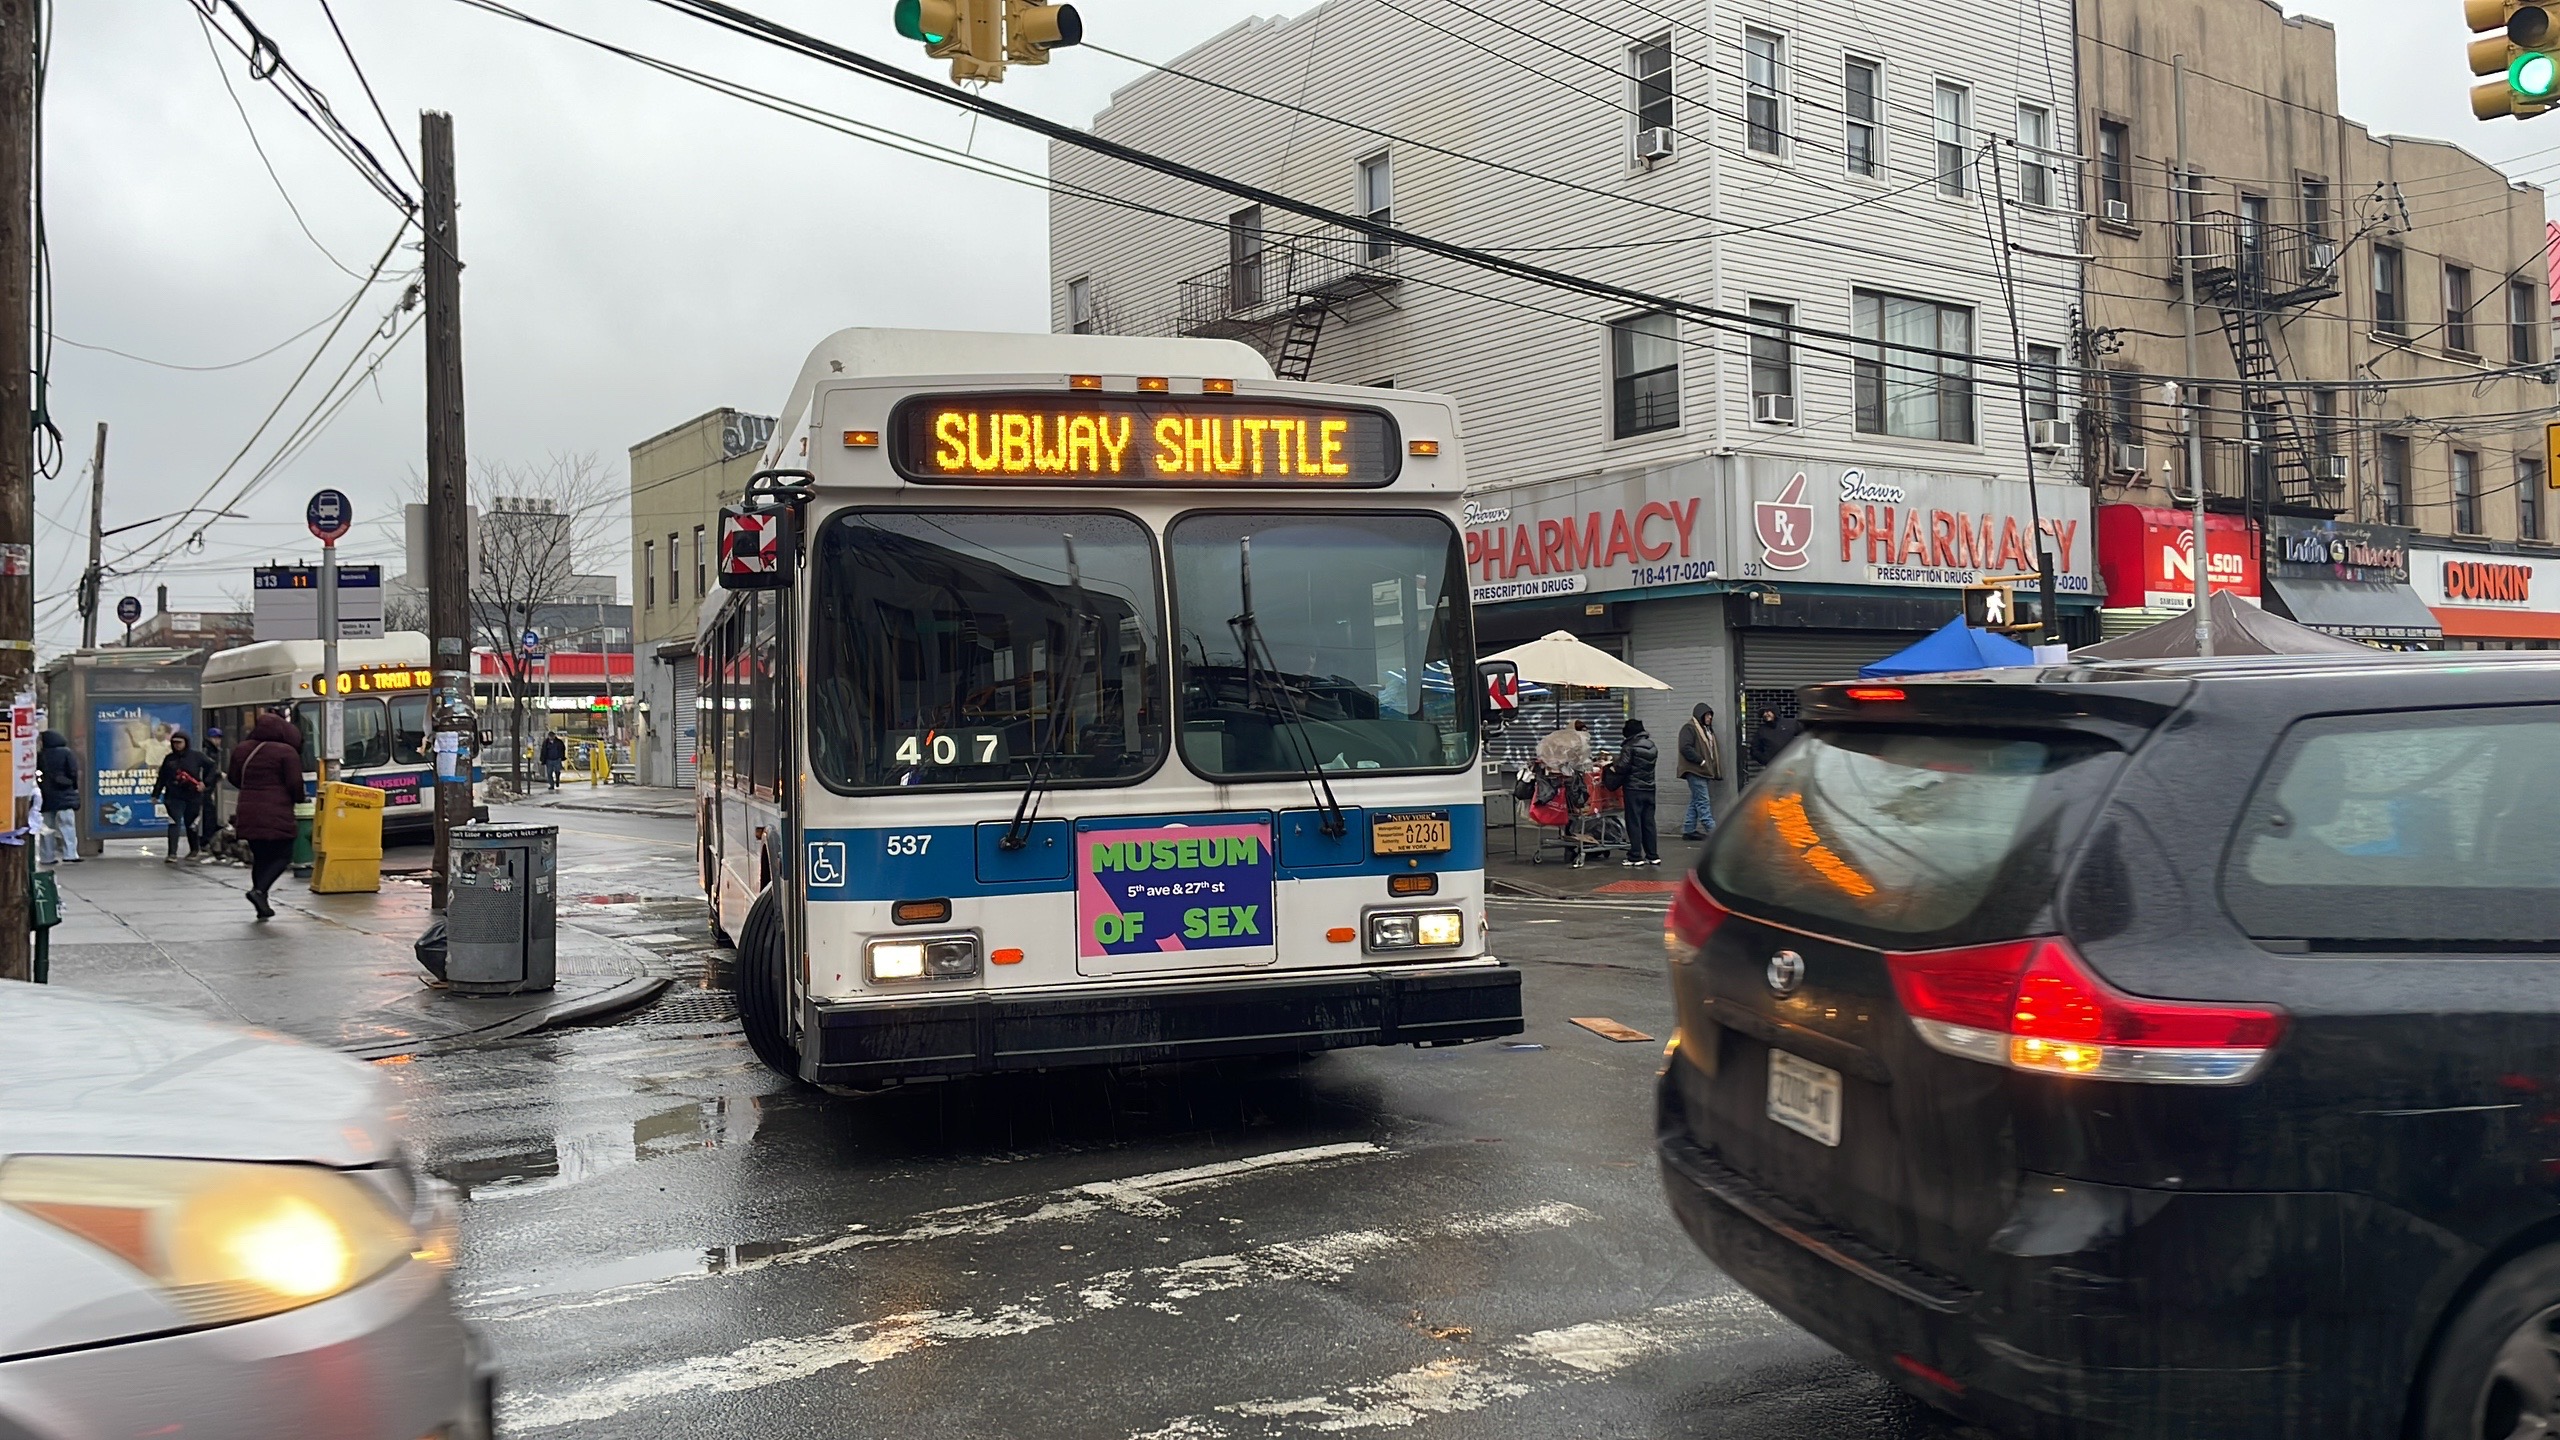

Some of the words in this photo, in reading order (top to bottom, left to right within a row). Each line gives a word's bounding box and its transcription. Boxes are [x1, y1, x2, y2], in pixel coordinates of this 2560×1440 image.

[935, 411, 1131, 474] SUBWAY
[1153, 417, 1349, 476] SHUTTLE
[1841, 467, 1905, 501] Shawn
[1463, 501, 1509, 527] Shawn
[1466, 497, 1700, 581] PHARMACY
[1840, 503, 2077, 573] PHARMACY
[1631, 560, 1716, 586] 718-417-0200
[1743, 562, 1763, 577] 321
[2163, 545, 2243, 581] NLSON
[255, 575, 278, 588] B13
[292, 575, 308, 587] 11
[1877, 567, 1942, 584] PRESCRIPTION
[1944, 570, 1974, 585] DRUGS
[2014, 573, 2088, 591] 718-7-0200
[2443, 559, 2533, 602] DUNKIN'
[1473, 582, 1539, 601] PRESCRIPTION
[1541, 577, 1575, 592] DRUGS
[2159, 597, 2184, 606] SAMSUNG
[359, 673, 370, 690] L
[373, 671, 411, 689] TRAIN
[413, 670, 432, 687] TO
[98, 778, 137, 787] DEMAND
[98, 786, 133, 796] CHOOSE
[368, 777, 417, 789] MUSEUM
[395, 794, 417, 804] SEX
[886, 834, 932, 856] 537
[1091, 836, 1259, 873] MUSEUM
[1127, 884, 1145, 898] 5th
[1146, 886, 1171, 897] ave
[1172, 884, 1184, 895] &
[1184, 881, 1210, 895] 27th
[1211, 881, 1226, 893] st
[1093, 911, 1145, 945] OF
[1183, 904, 1261, 939] SEX
